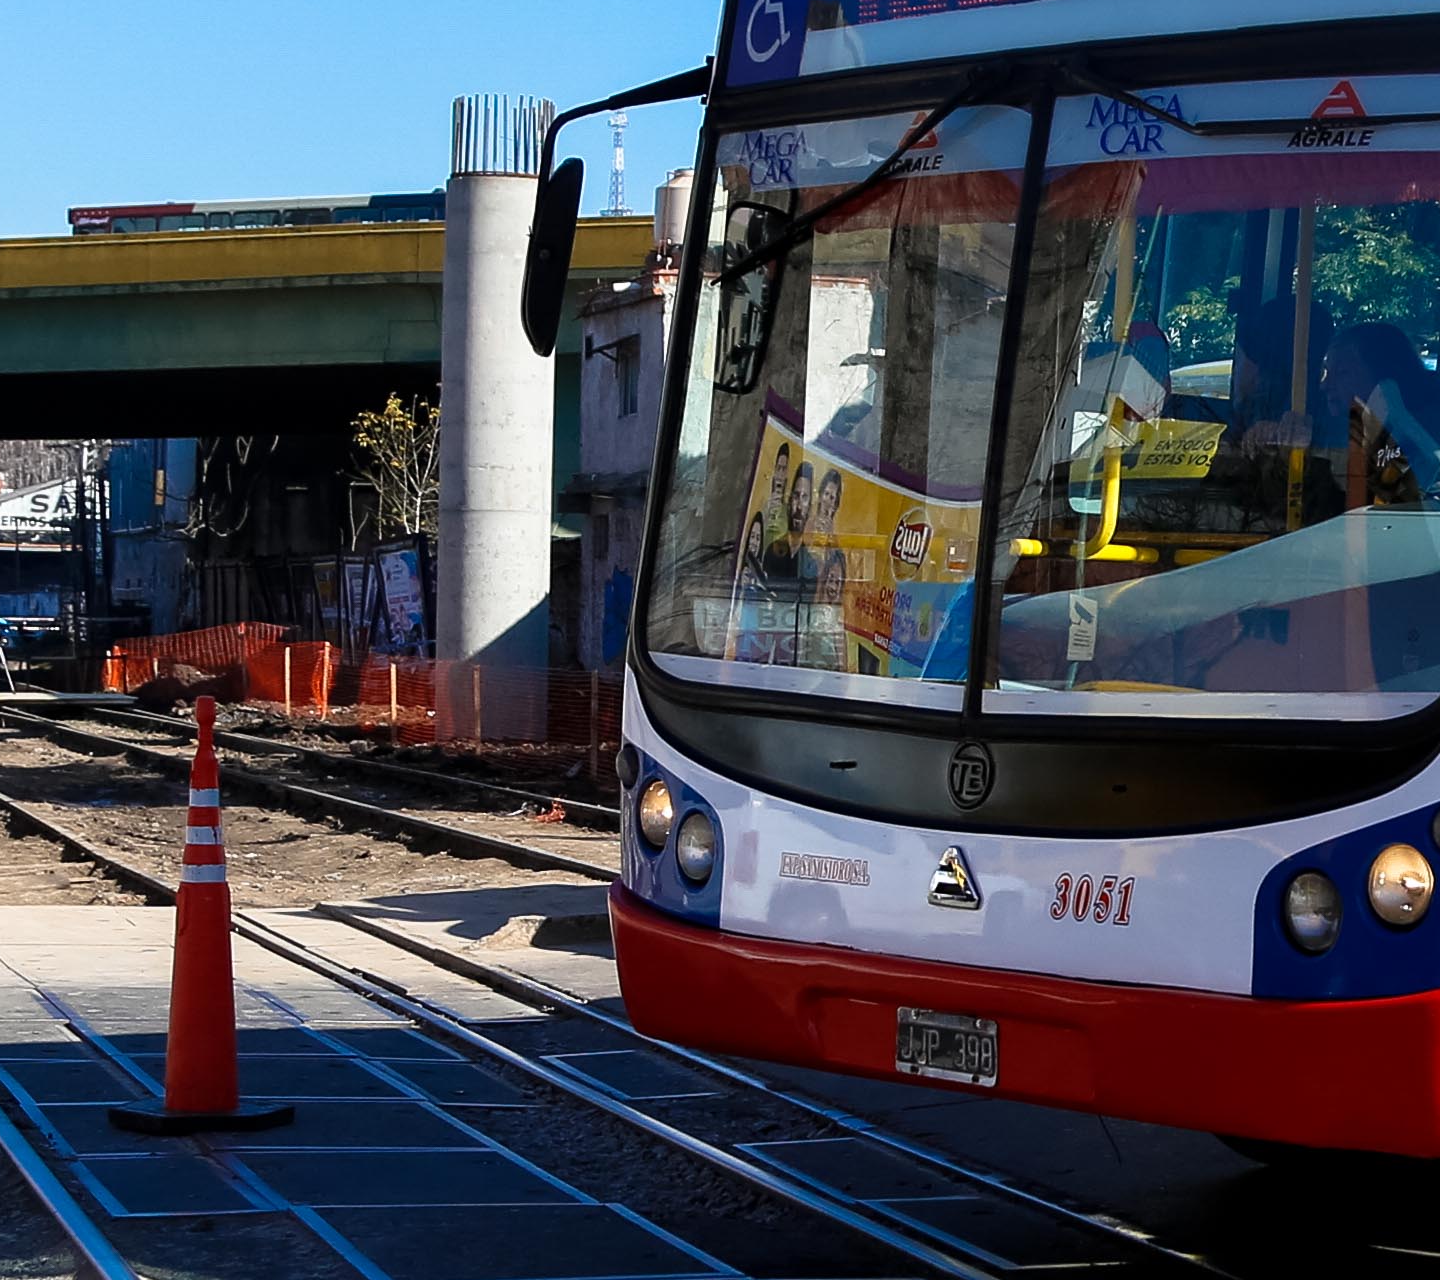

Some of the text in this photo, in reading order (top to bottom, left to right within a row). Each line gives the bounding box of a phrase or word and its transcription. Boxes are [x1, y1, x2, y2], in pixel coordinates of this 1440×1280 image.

[1100, 122, 1168, 156] CAR
[1286, 129, 1375, 148] AGRALE
[749, 158, 794, 186] CAR
[819, 858, 851, 882] ISIDRO
[1049, 872, 1136, 926] 3051
[900, 1025, 940, 1066] JJP
